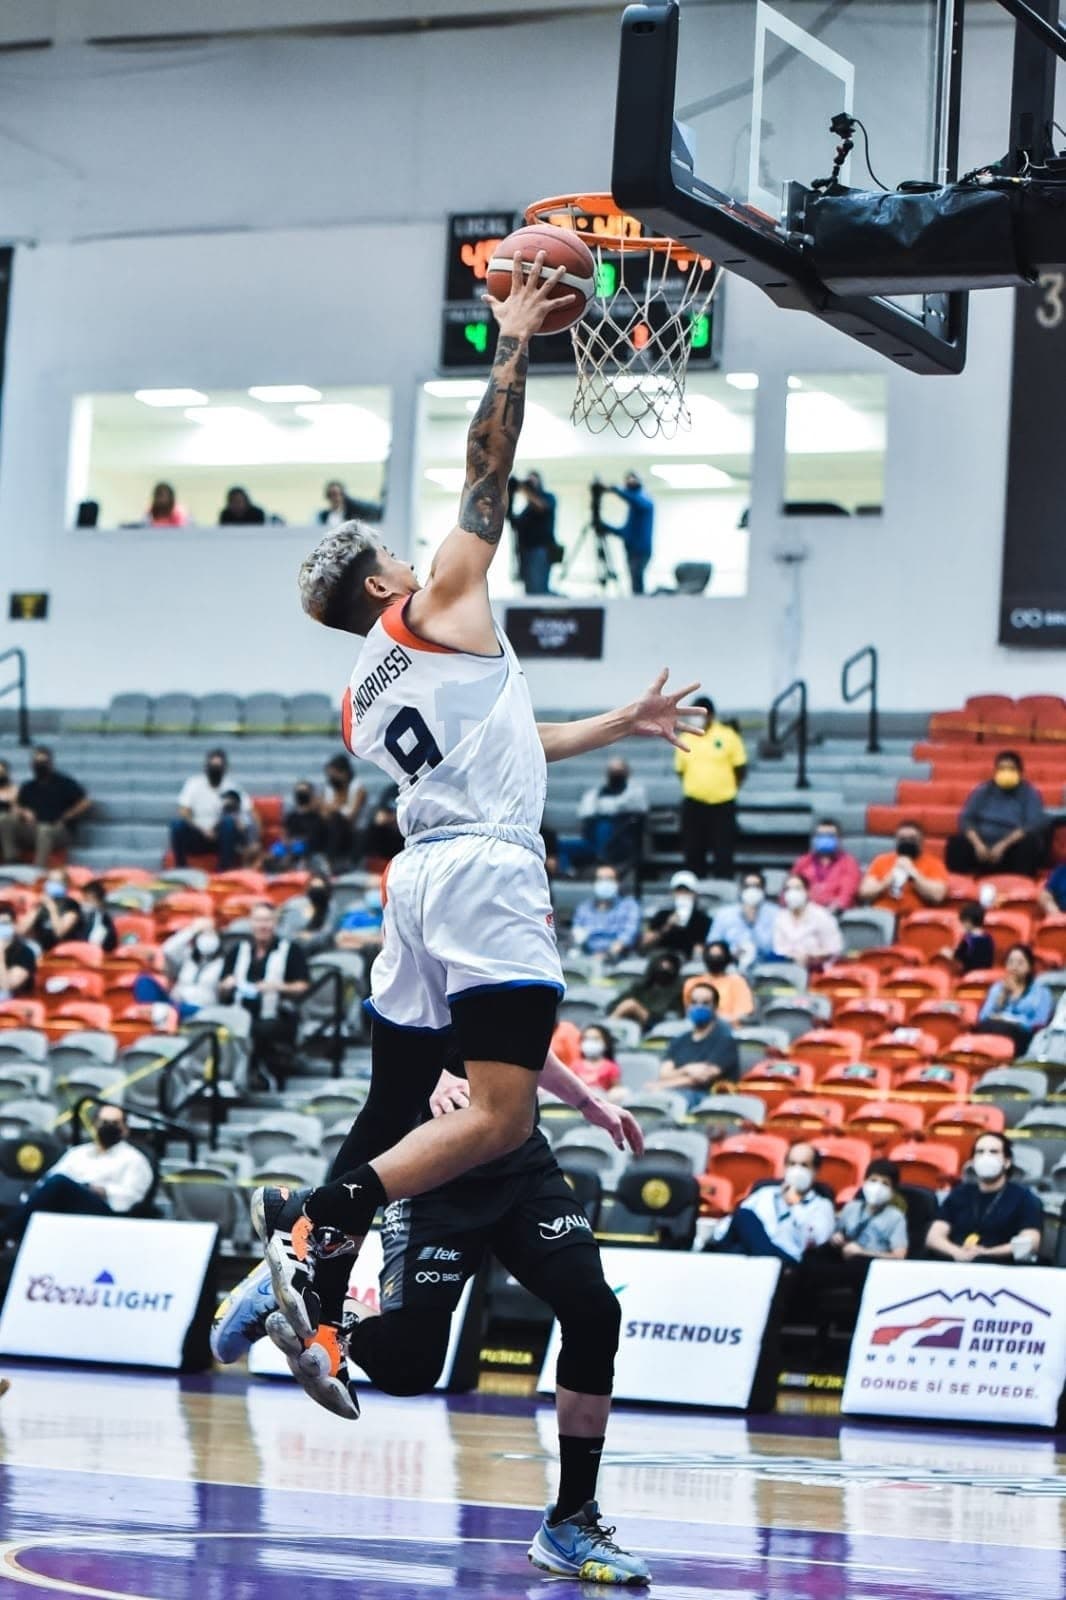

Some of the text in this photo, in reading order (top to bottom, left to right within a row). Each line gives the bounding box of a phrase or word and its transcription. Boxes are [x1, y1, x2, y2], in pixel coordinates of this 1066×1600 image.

[1036, 272, 1064, 329] 3
[353, 645, 412, 725] ANDRIASSI
[384, 705, 444, 786] 9
[26, 1273, 174, 1312] Coors LIGHT
[625, 1320, 744, 1345] STRENDUS
[972, 1318, 1034, 1337] GRUPO
[968, 1337, 1047, 1356] AUTOFIN
[866, 1353, 1042, 1372] MONTERREY
[860, 1376, 919, 1392] DONDE
[948, 1382, 970, 1395] SE
